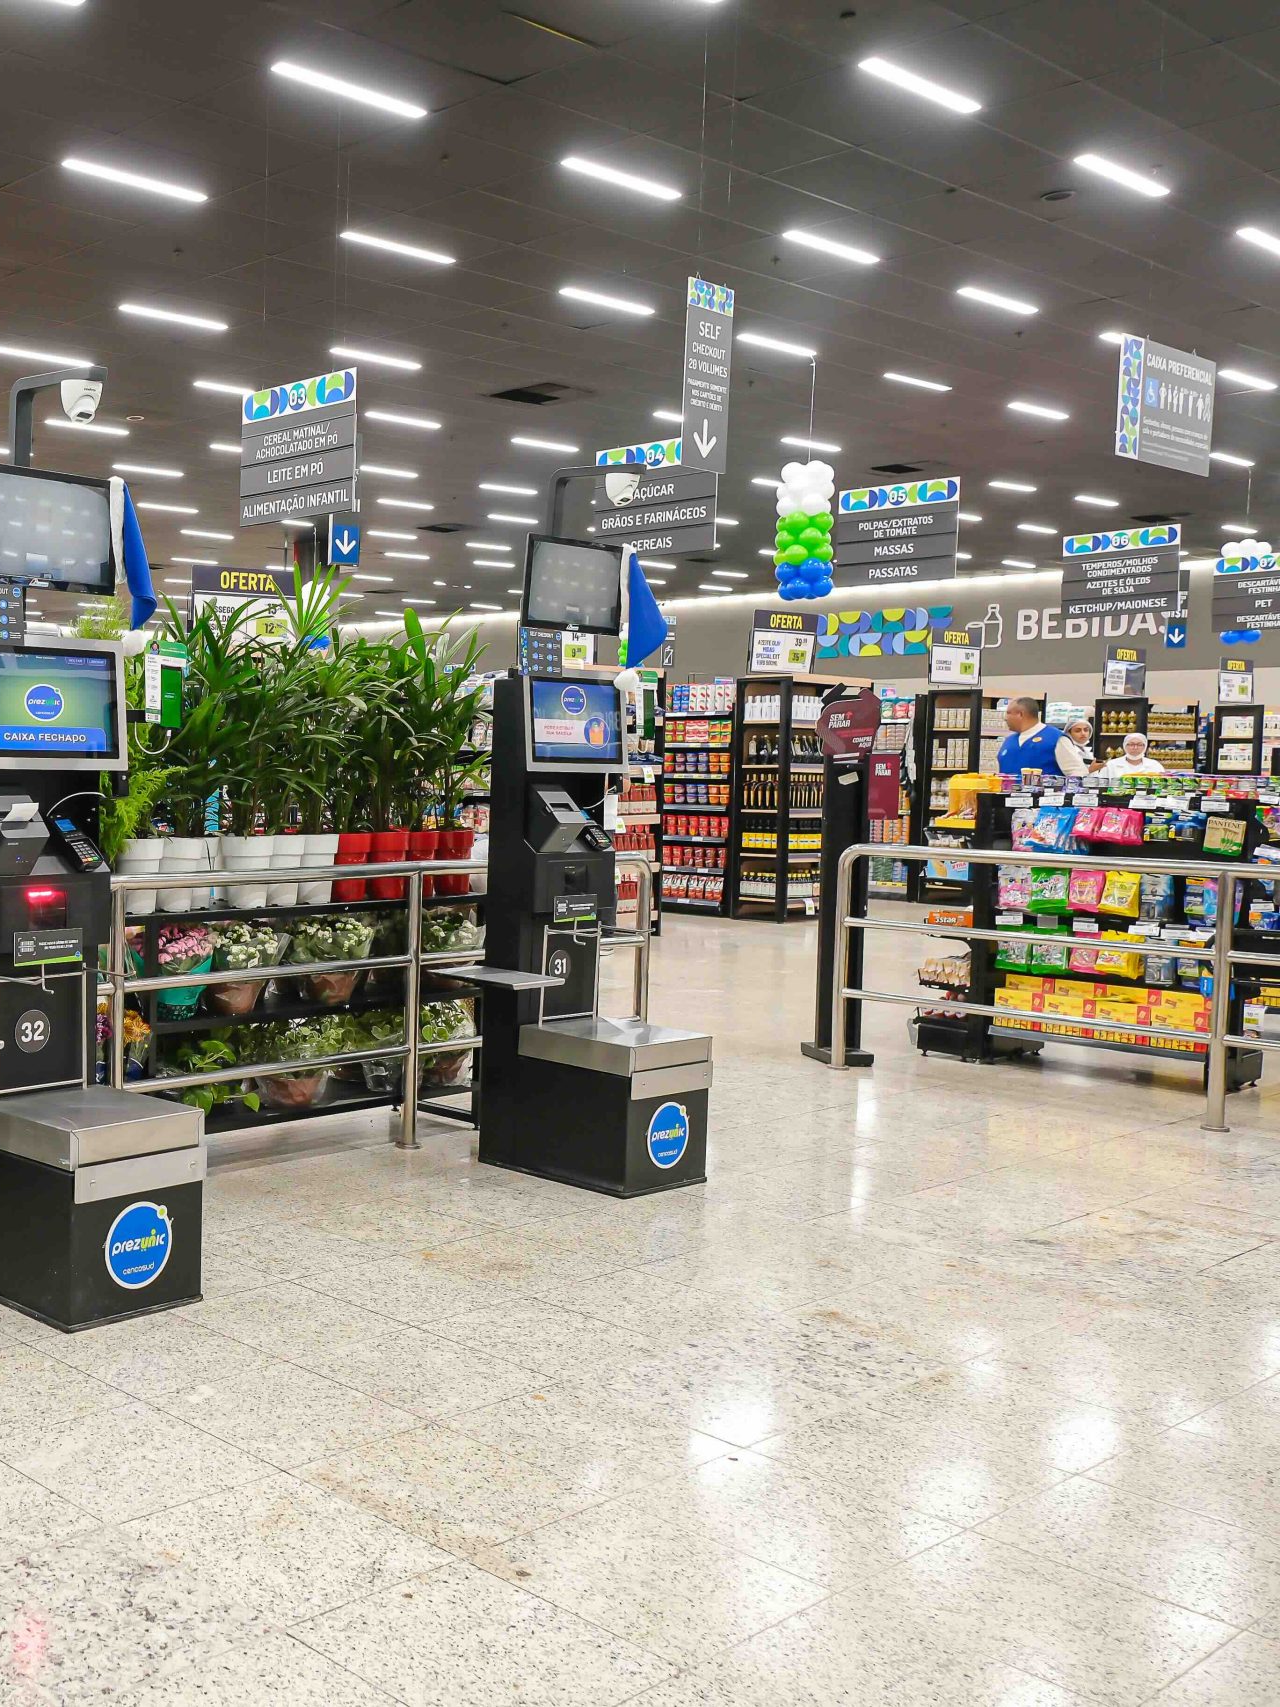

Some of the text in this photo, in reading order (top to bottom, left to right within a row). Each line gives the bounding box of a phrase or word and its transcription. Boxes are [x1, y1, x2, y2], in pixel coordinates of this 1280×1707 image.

[699, 321, 722, 341] SELF
[692, 341, 726, 361] CHECKOUT
[688, 358, 728, 378] 20 VOLUMES
[1147, 353, 1213, 386] CAIXA PREFERENCIAL
[290, 388, 307, 406] 03
[263, 422, 330, 447] CEREAL MATINAL/
[255, 431, 338, 460] ACHOCOLATADO EM PÓ
[646, 448, 664, 464] 04
[267, 458, 324, 484] LEITE EM PÓ
[634, 484, 675, 501] AÇÚCAR
[889, 489, 907, 503] 05
[242, 489, 349, 519] ALIMENTAÇÃO INFANTIL
[601, 506, 707, 530] GRÃOS E FARINÁCEOS
[859, 516, 934, 531] POLPAS/EXTRATOS
[873, 526, 918, 538] DE TOMATE
[631, 537, 673, 552] CEREAIS
[1112, 535, 1128, 547] 06
[874, 544, 914, 556] MASSAS
[1081, 557, 1158, 571] TEMPEROS/MOLHOS
[1087, 565, 1152, 578] CONDIMENTADOS
[869, 566, 918, 579] PASSATAS
[220, 571, 275, 592] OFERTA
[1086, 579, 1118, 589] AZEITES
[1102, 585, 1134, 595] DE SOJA
[1069, 598, 1168, 614] KETCHUP/MAIONESE
[1255, 599, 1273, 608] PET
[770, 614, 803, 629] OFERTA
[944, 631, 969, 645] OFERTA
[1116, 649, 1137, 661] OFERTA
[1227, 660, 1246, 671] OFERTA
[828, 719, 851, 729] PARAR
[829, 713, 846, 721] SEM
[4, 732, 87, 742] CAIXA FECHADO
[852, 736, 872, 744] COMPRE
[1208, 819, 1241, 830] PANTENE
[554, 957, 567, 974] 31
[21, 1020, 45, 1043] 32
[651, 1124, 685, 1142] prezunic
[112, 1228, 165, 1256] prezunic
[122, 1261, 155, 1275] cencosud
